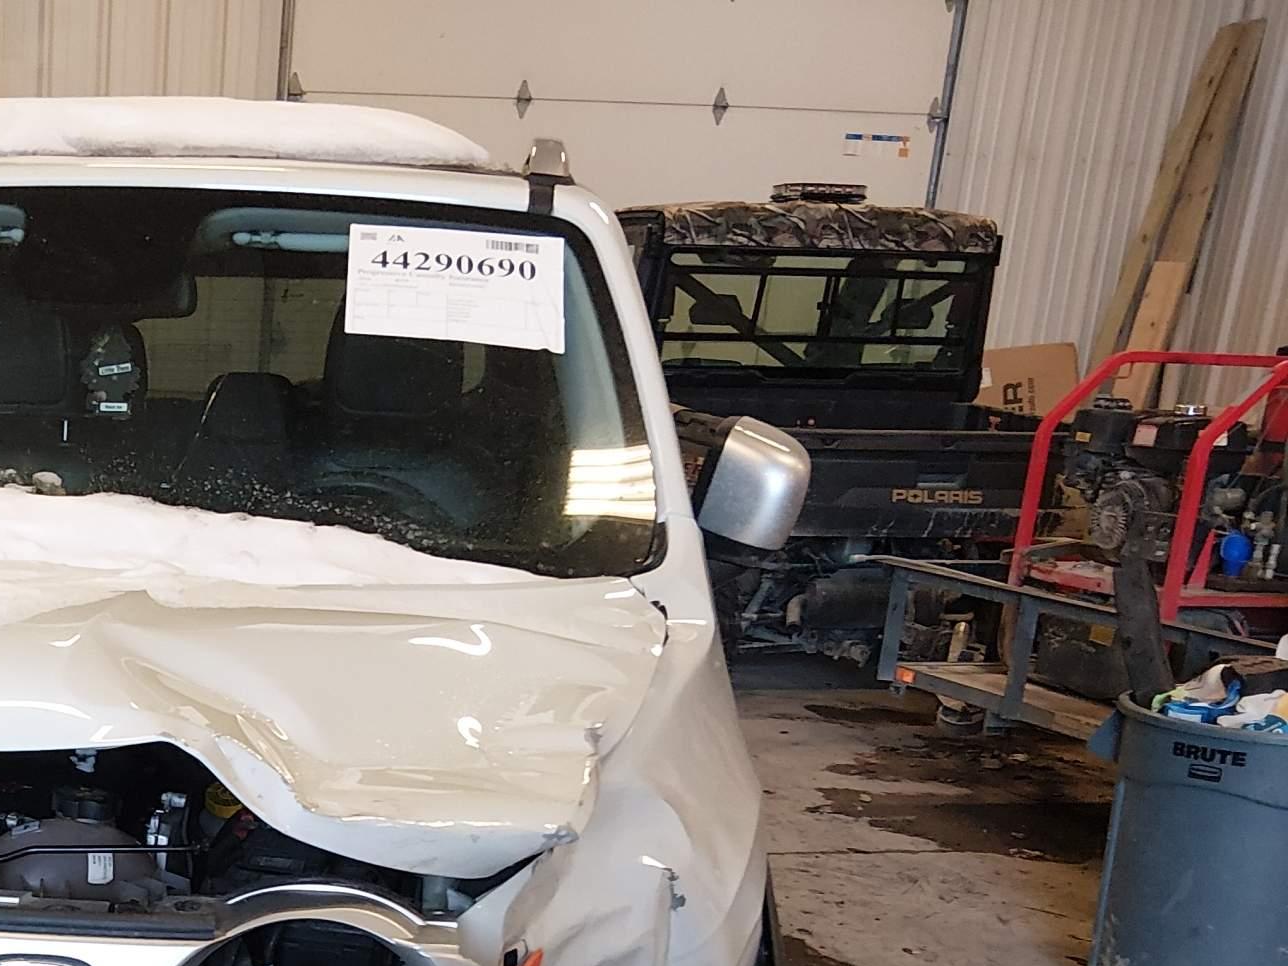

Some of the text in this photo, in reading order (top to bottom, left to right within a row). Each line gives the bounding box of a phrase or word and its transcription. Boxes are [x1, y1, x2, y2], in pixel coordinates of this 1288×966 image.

[371, 250, 536, 281] 44290690
[891, 489, 983, 504] POLARIS
[1173, 741, 1247, 767] BRUTE
